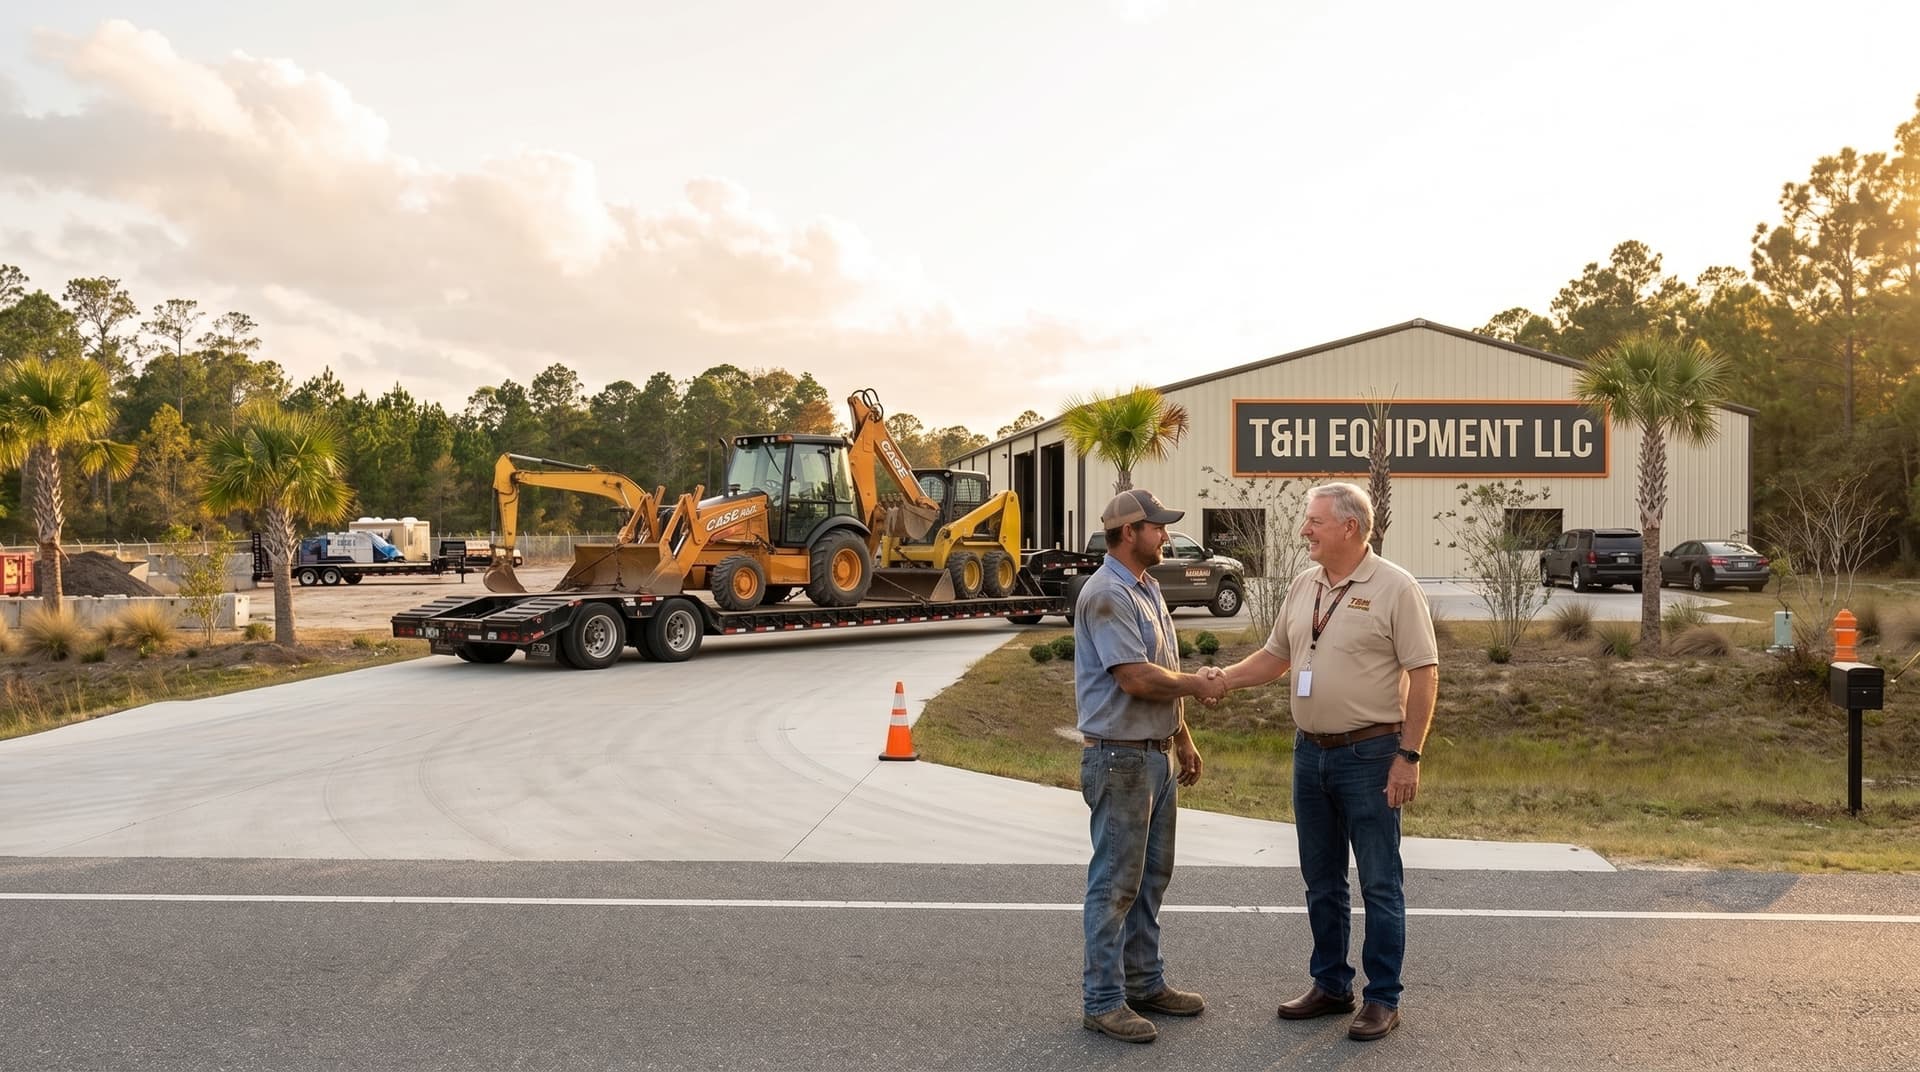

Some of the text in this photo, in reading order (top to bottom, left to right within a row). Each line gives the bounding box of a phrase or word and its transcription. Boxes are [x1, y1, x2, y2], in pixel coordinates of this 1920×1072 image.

[1249, 418, 1594, 459] T&H EQUIPMENT LLC
[881, 440, 909, 480] CASE
[706, 508, 740, 532] CASE
